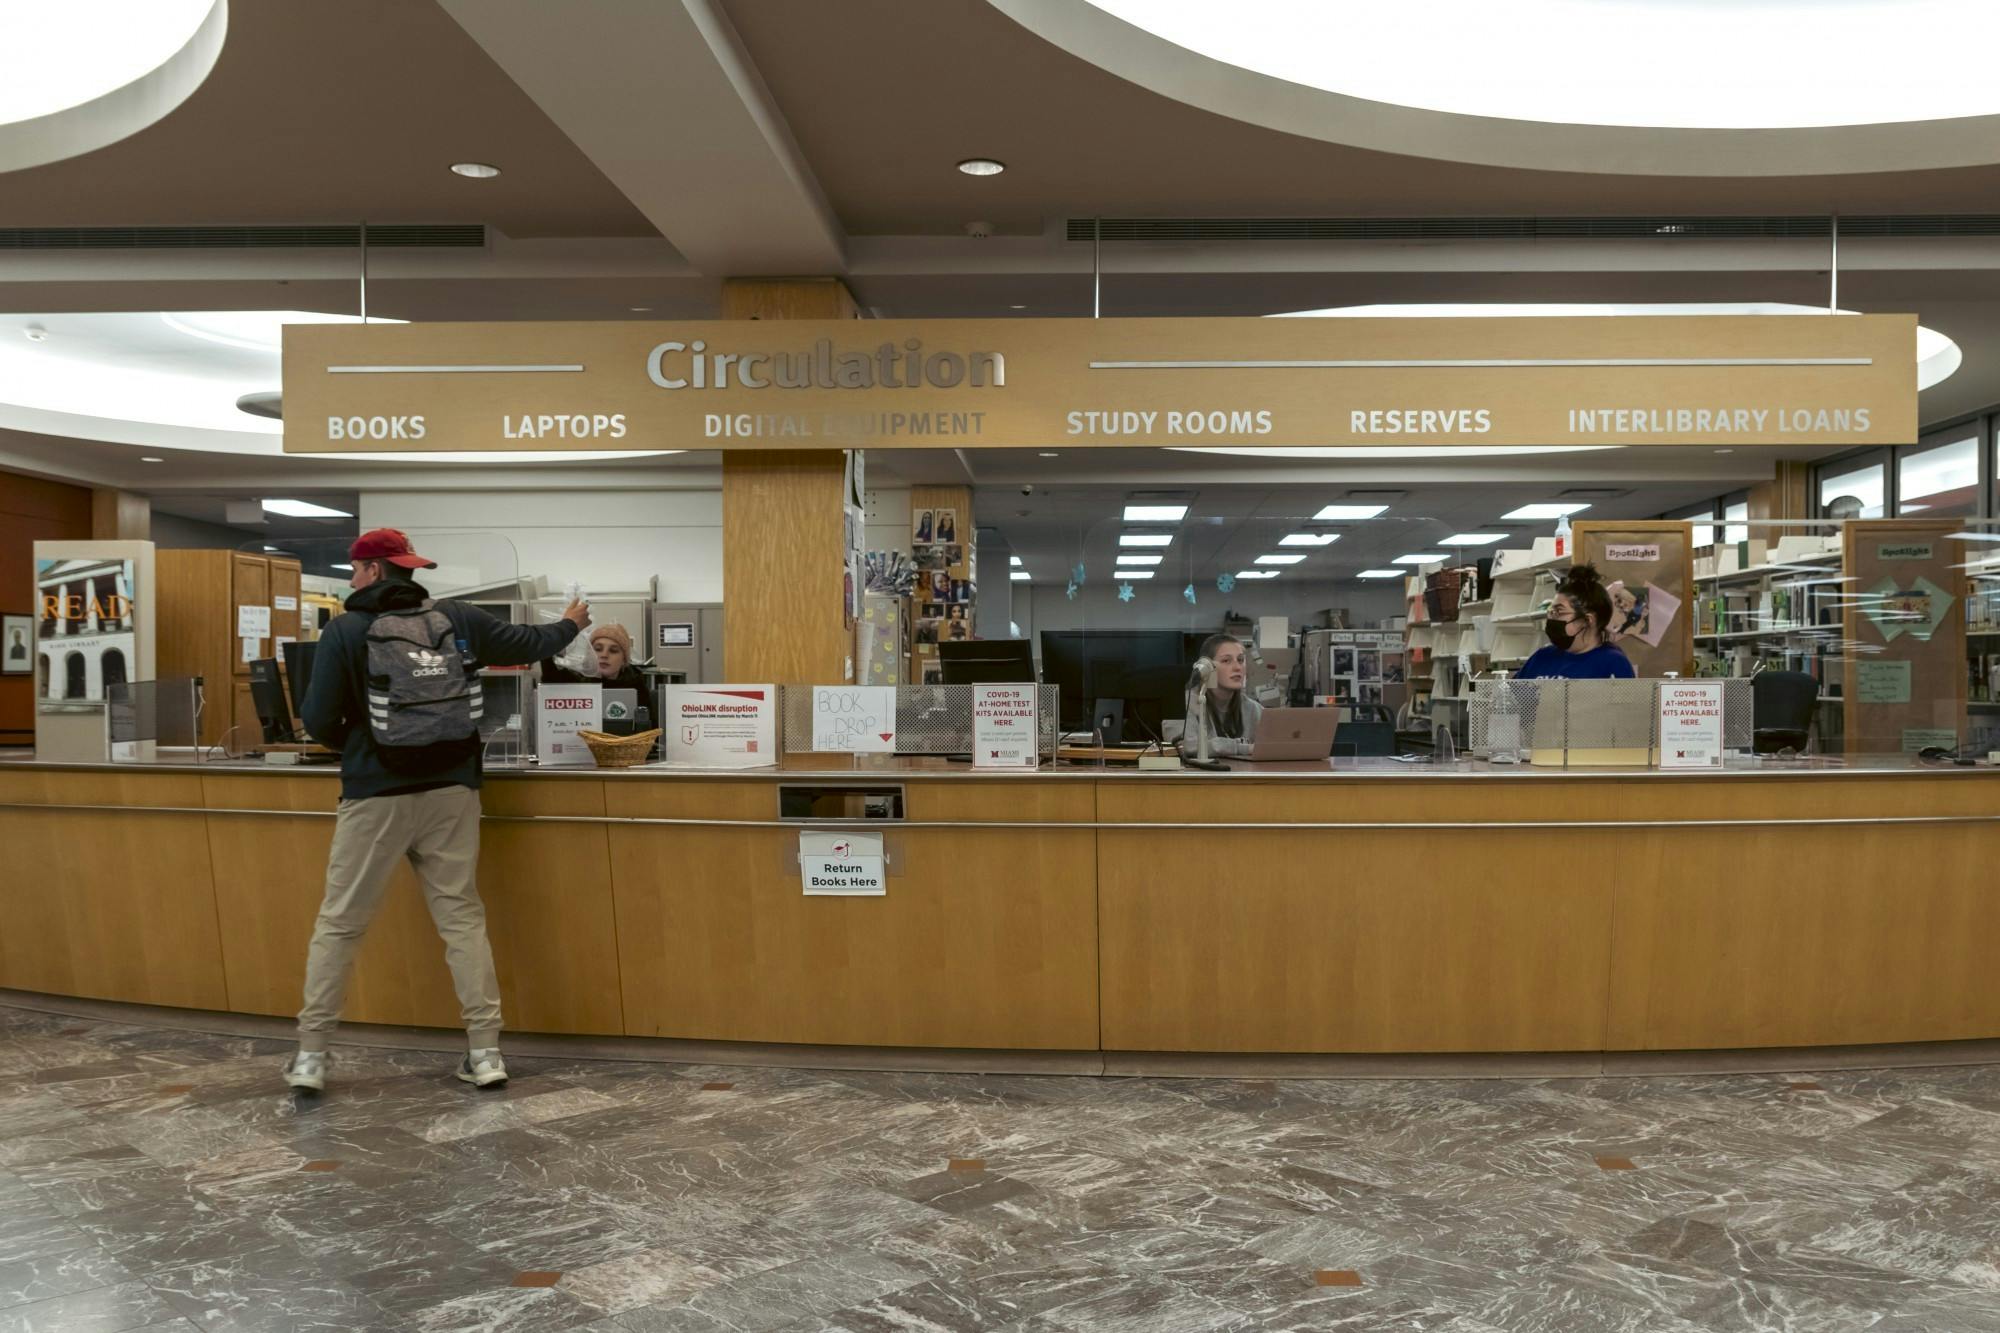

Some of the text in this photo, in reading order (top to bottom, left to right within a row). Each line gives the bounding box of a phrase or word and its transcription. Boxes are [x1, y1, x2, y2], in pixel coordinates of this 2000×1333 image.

[647, 339, 1005, 390] Circulation
[328, 416, 426, 439] BOOKS
[503, 414, 627, 439] LAPTOPS
[705, 412, 986, 437] DIGITAL EUIPMENT
[1067, 411, 1272, 435] STUDY ROOMS
[1351, 409, 1490, 433] RESERVES
[1569, 408, 1871, 433] INTERLIBRARY LOANS
[1608, 549, 1657, 558] Spotlight
[41, 594, 131, 619] READ
[545, 699, 592, 709] HOURS
[681, 704, 758, 713] OhioLINK disruption
[818, 690, 865, 713] BOOK
[833, 715, 876, 736] DROP
[817, 733, 856, 750] HERE
[824, 863, 862, 873] Return
[811, 877, 878, 886] Books Here
